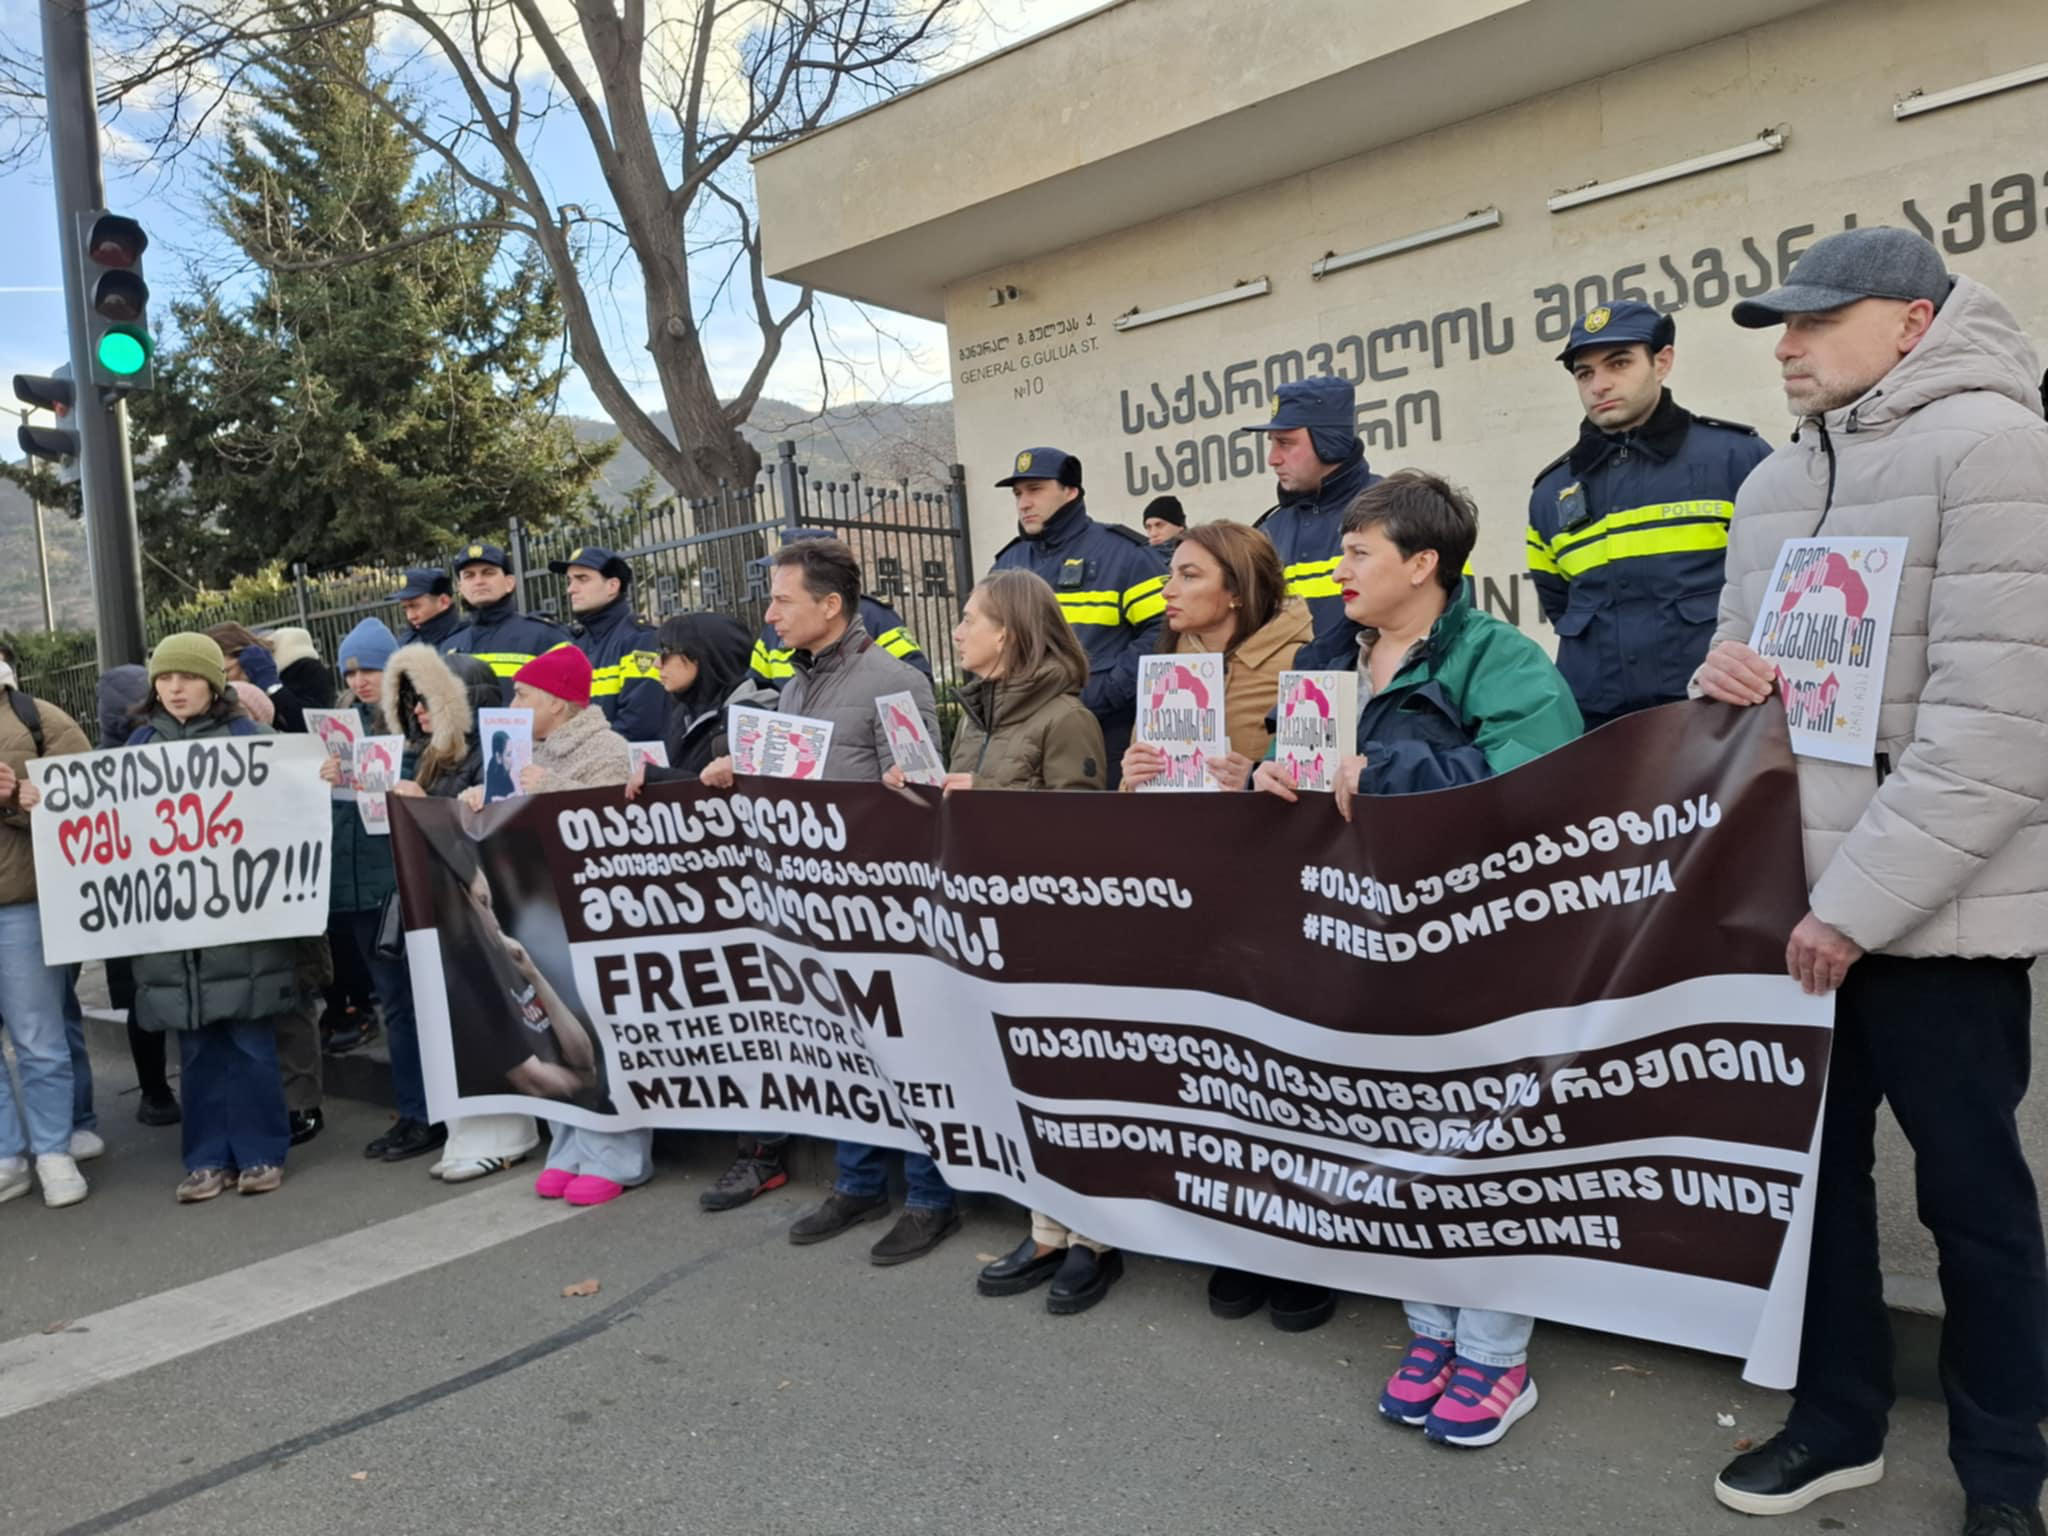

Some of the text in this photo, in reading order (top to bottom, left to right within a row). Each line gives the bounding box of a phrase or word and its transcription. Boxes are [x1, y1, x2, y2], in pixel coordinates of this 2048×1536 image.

[959, 337, 1010, 361] გენერალ
[960, 336, 1100, 384] GENERAL G.GULUA ST.
[1661, 502, 1723, 518] POLICE
[43, 741, 274, 813] მედიასთან
[58, 790, 244, 866] ომს ვერ
[557, 793, 847, 852] თავისუფლება
[1300, 794, 1722, 916] #თავისუფლებამზიას
[79, 841, 323, 932] მოიგებთ!!!
[755, 848, 774, 876] და
[942, 869, 1193, 909] ხელმძღვანელს
[1303, 859, 1677, 963] #FREEDOMFORMZIA
[579, 874, 1005, 971] მზია ამაღლობელს!
[594, 942, 904, 1038] FREEDOM
[611, 1022, 662, 1046] FOR
[672, 1013, 723, 1041] THE
[729, 1008, 848, 1045] DIRECTOR
[617, 1039, 782, 1071] BATUMELEBI
[789, 1041, 832, 1069] AND
[627, 1074, 749, 1110] MZIA
[1007, 1026, 1806, 1112] თავისუფლება ივანიშვილის რეჟიმის
[1031, 1115, 1174, 1156] FREEDOM
[1179, 1131, 1243, 1169] FOR
[1250, 1139, 1407, 1210] POLITICAL
[1411, 1166, 1664, 1210] PRISONERS
[1174, 1171, 1622, 1250] THE IVANISHVILI REGIME!
